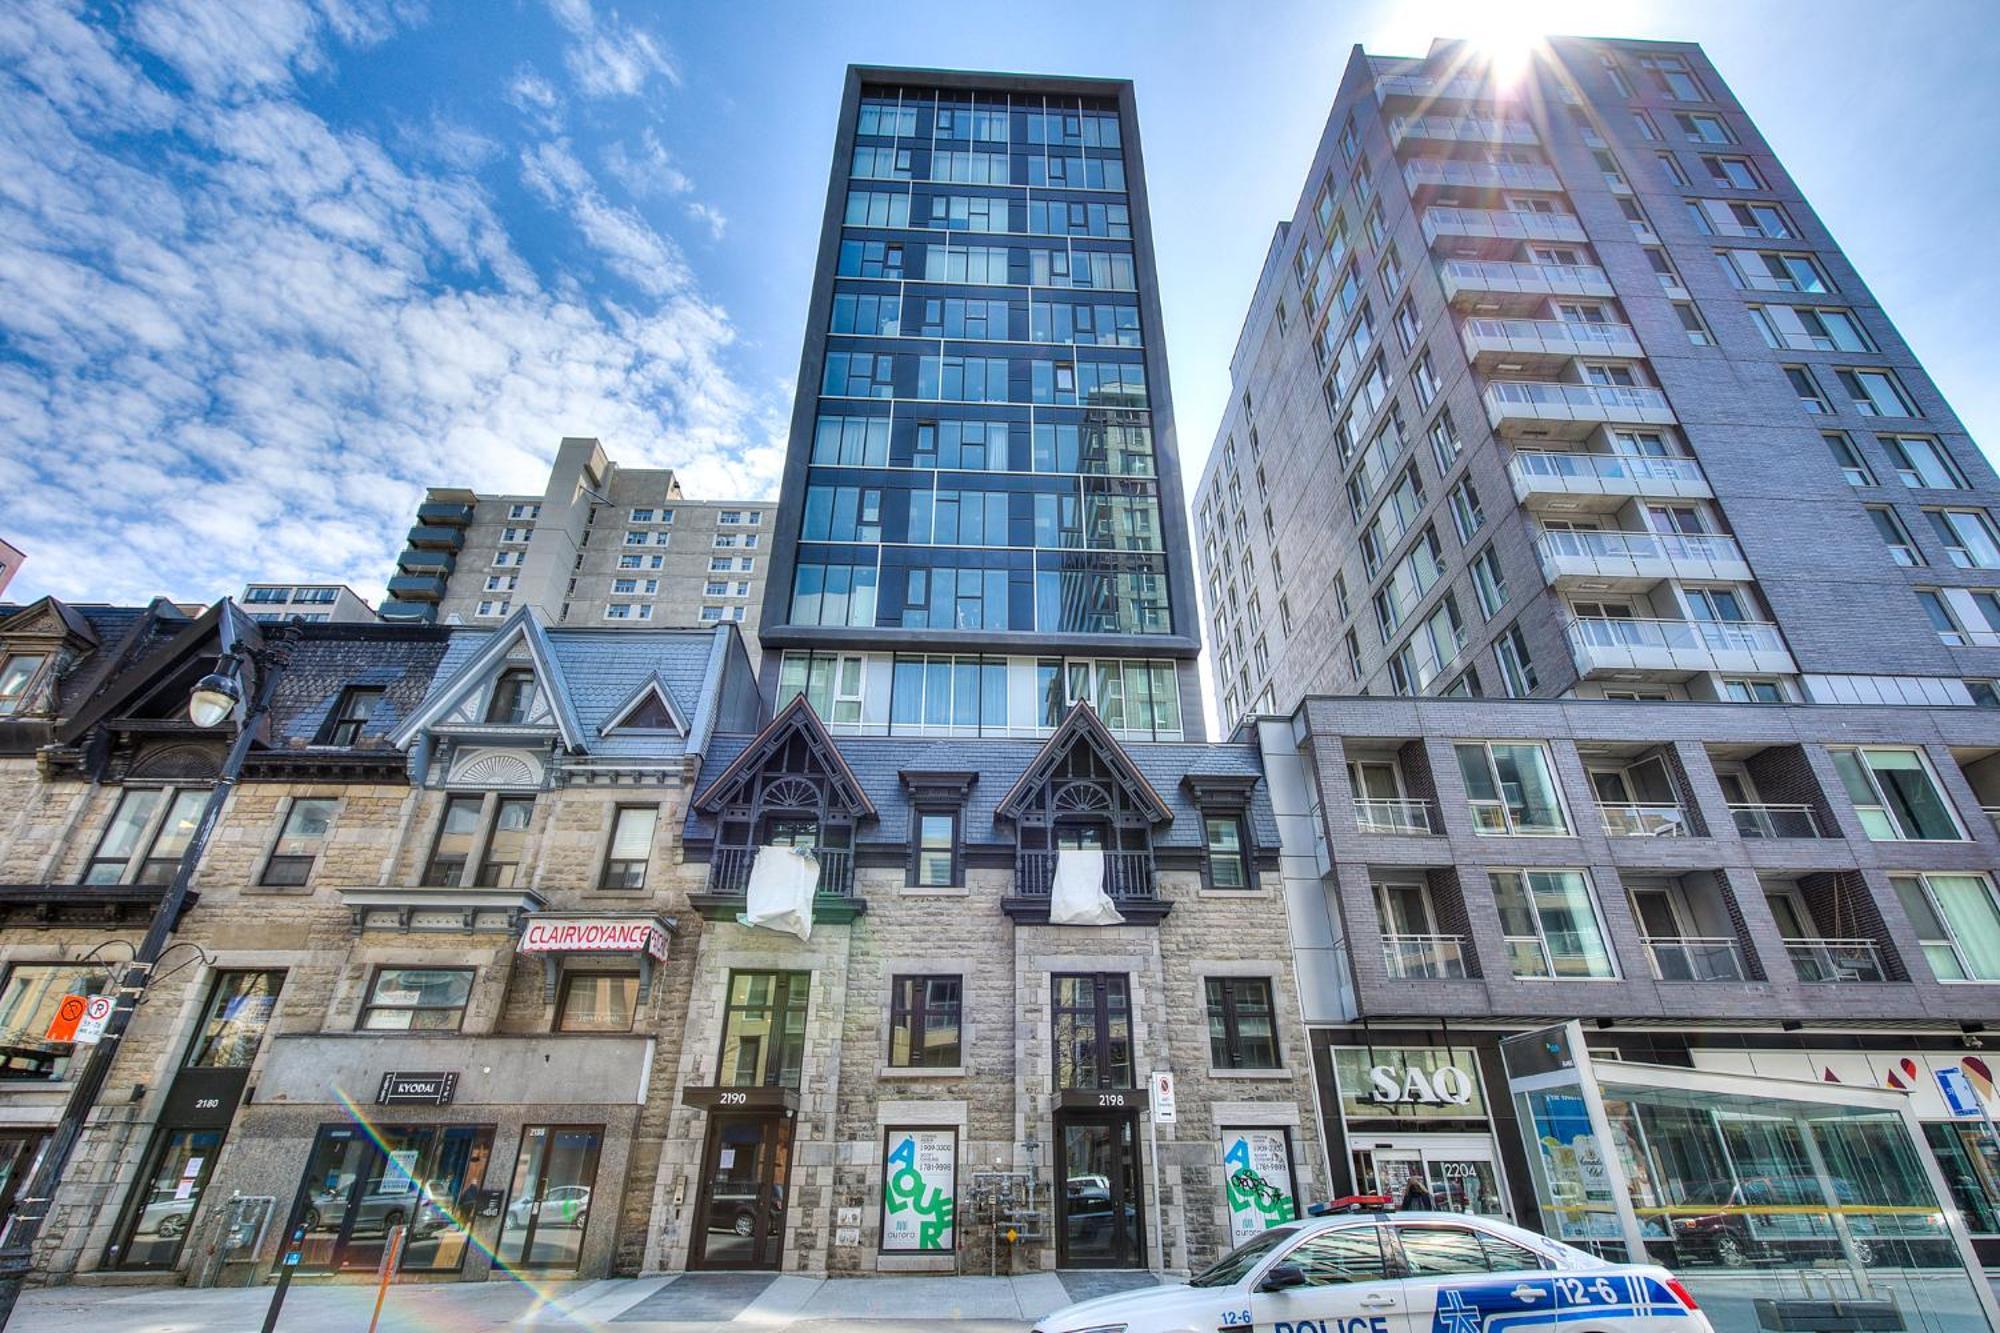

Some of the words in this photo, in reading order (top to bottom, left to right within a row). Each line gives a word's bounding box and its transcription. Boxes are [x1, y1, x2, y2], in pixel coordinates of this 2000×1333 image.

[529, 925, 651, 944] CLAIRVOYANCE
[398, 1083, 436, 1093] KYODAI
[1370, 1066, 1472, 1105] SAQ
[195, 1099, 219, 1109] 2180
[720, 1093, 747, 1104] 2190
[1099, 1094, 1125, 1106] 2198
[1444, 1163, 1478, 1178] 2204
[1556, 1278, 1618, 1304] 12-6
[1221, 1311, 1251, 1325] 12-6
